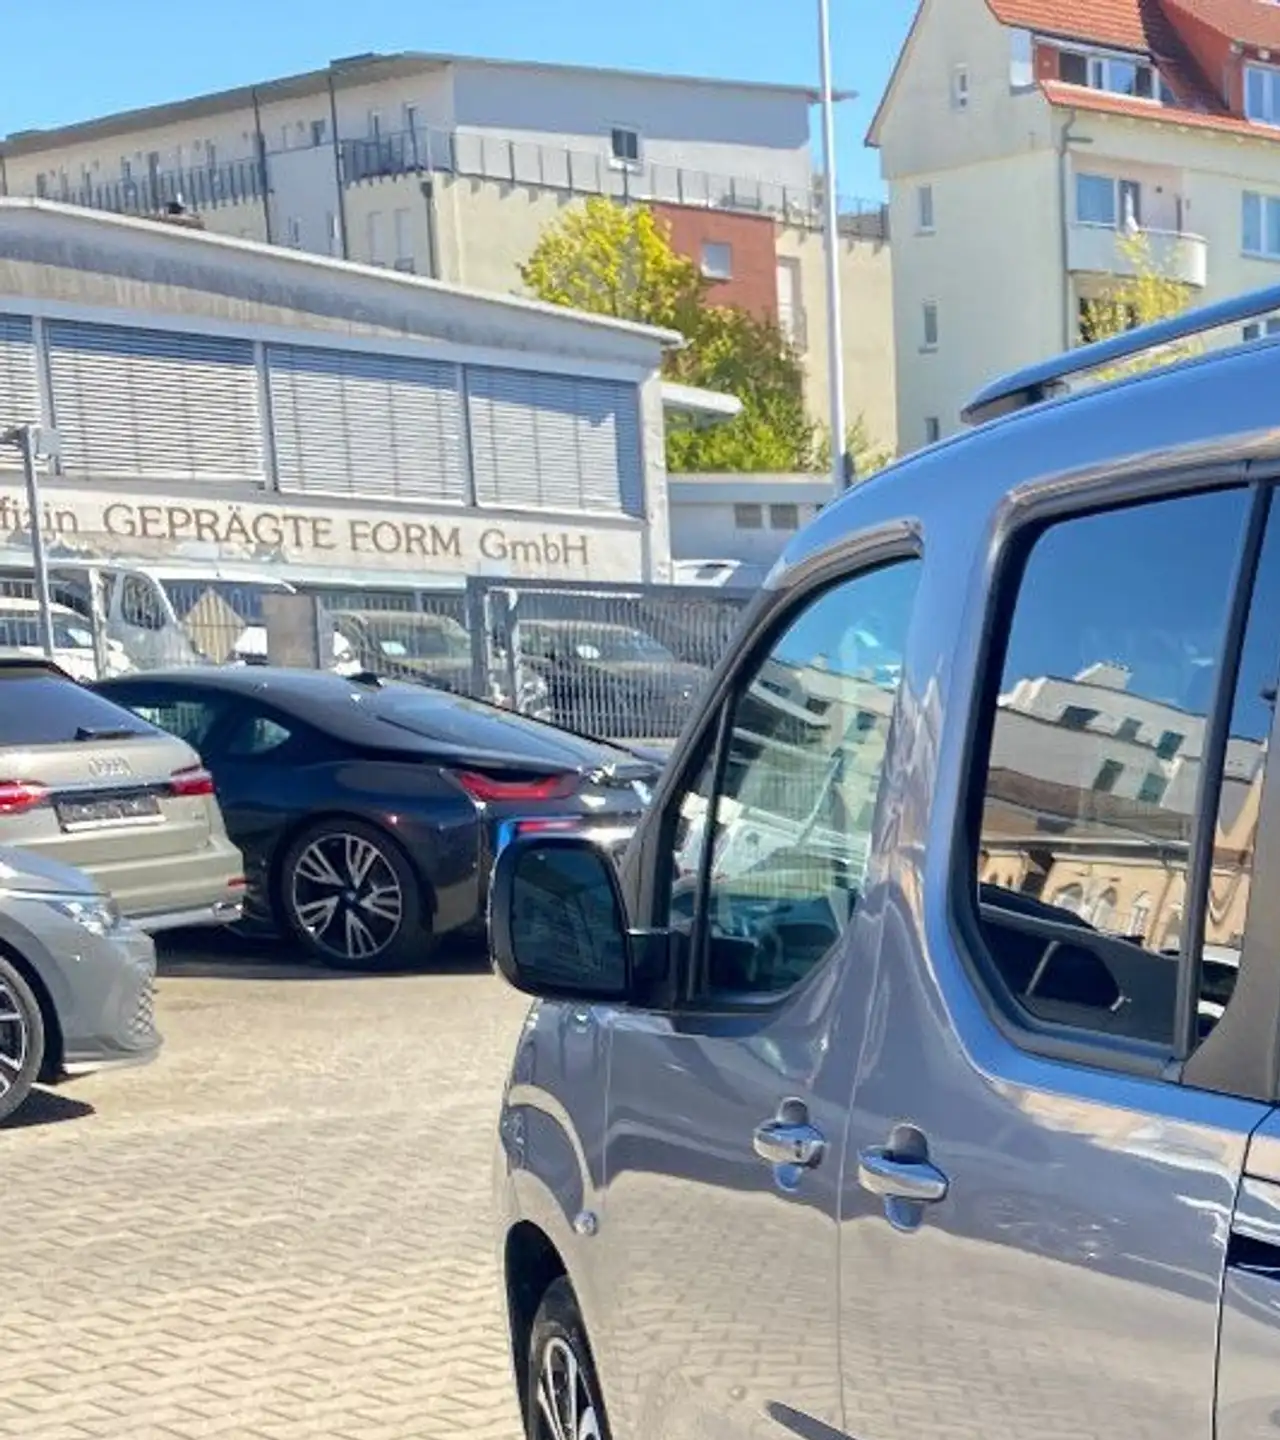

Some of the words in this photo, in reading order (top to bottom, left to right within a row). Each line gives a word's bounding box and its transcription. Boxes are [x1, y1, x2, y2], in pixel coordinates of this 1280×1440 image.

[102, 502, 337, 551] GEPRÄGTE
[347, 518, 462, 558] FORM
[479, 527, 590, 566] GmbH
